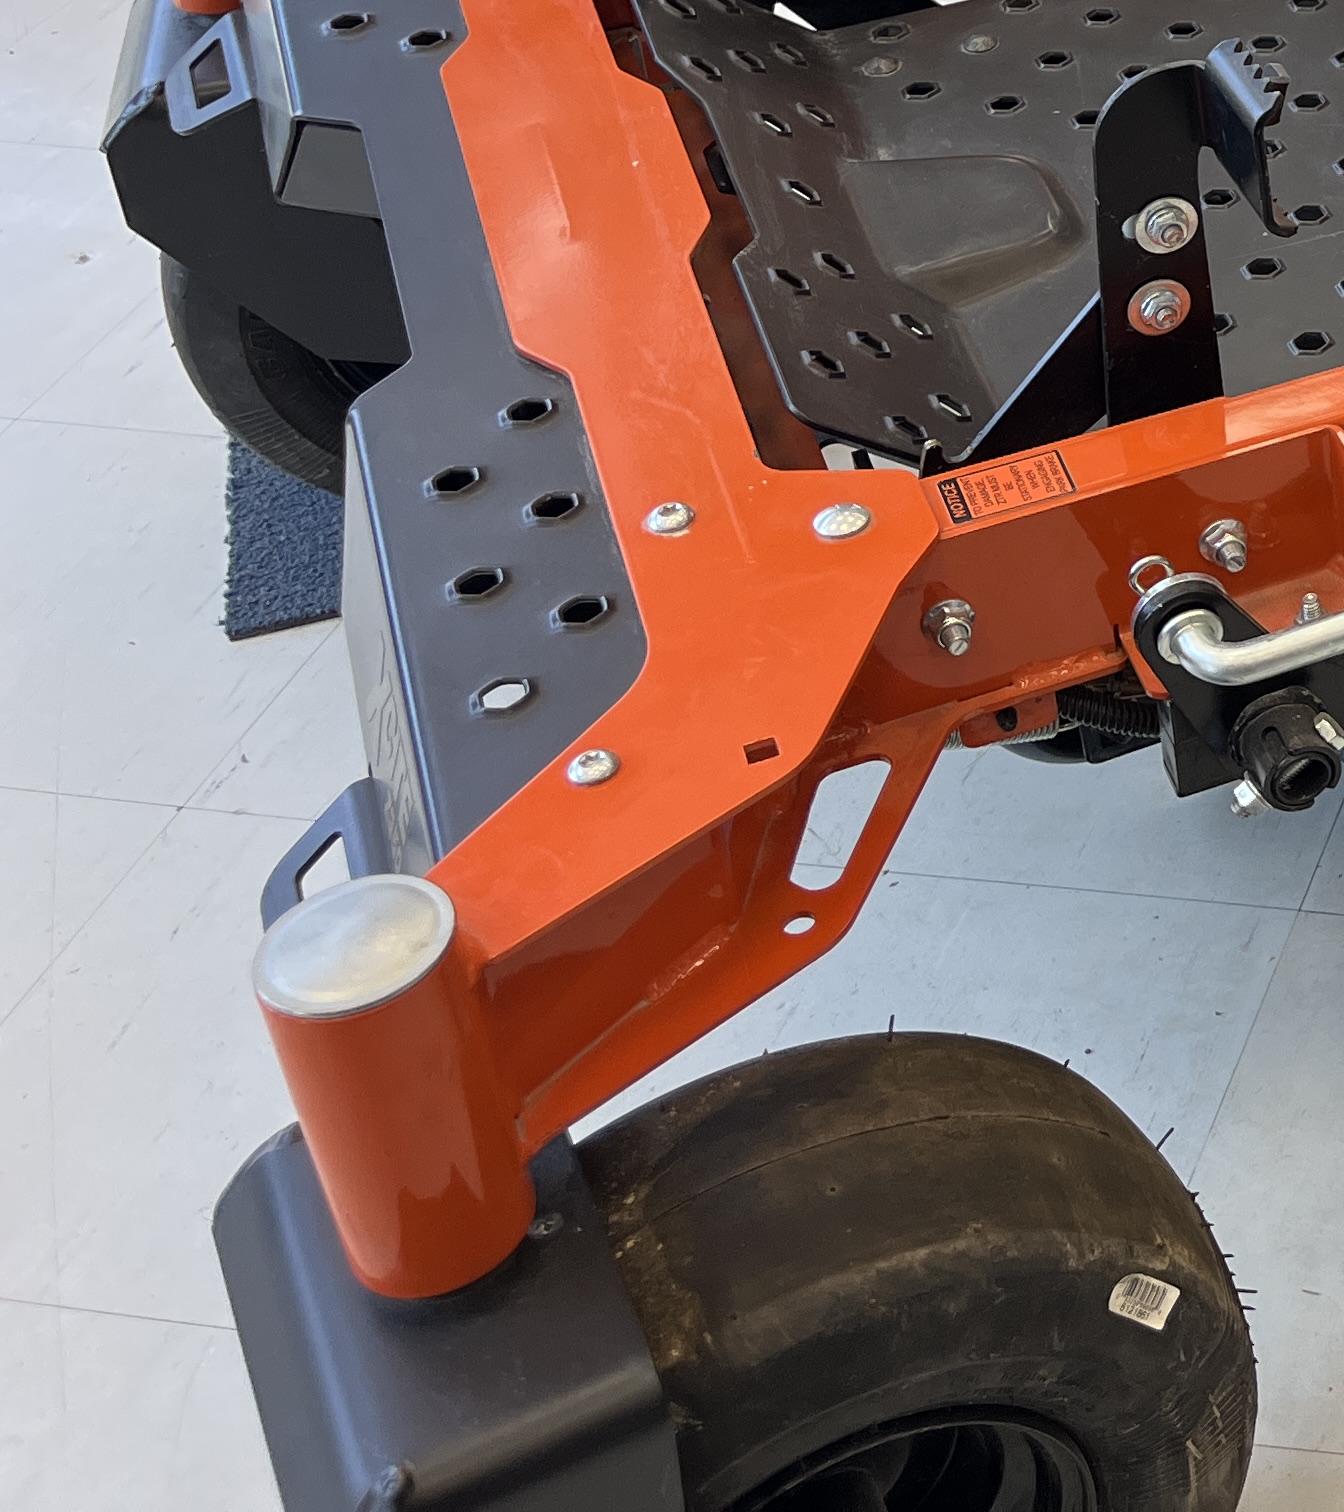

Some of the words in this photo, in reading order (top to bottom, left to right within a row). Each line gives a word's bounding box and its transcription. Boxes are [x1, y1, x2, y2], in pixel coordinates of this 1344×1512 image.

[1034, 460, 1055, 493] ENGAGING
[1044, 454, 1061, 477] BRAKE
[960, 477, 979, 506] PREVENT
[986, 474, 1002, 495] MUST
[1002, 481, 1014, 491] BE
[1009, 465, 1032, 502] STATIONARY
[1025, 470, 1040, 489] WHEN
[941, 482, 967, 518] NOTICE
